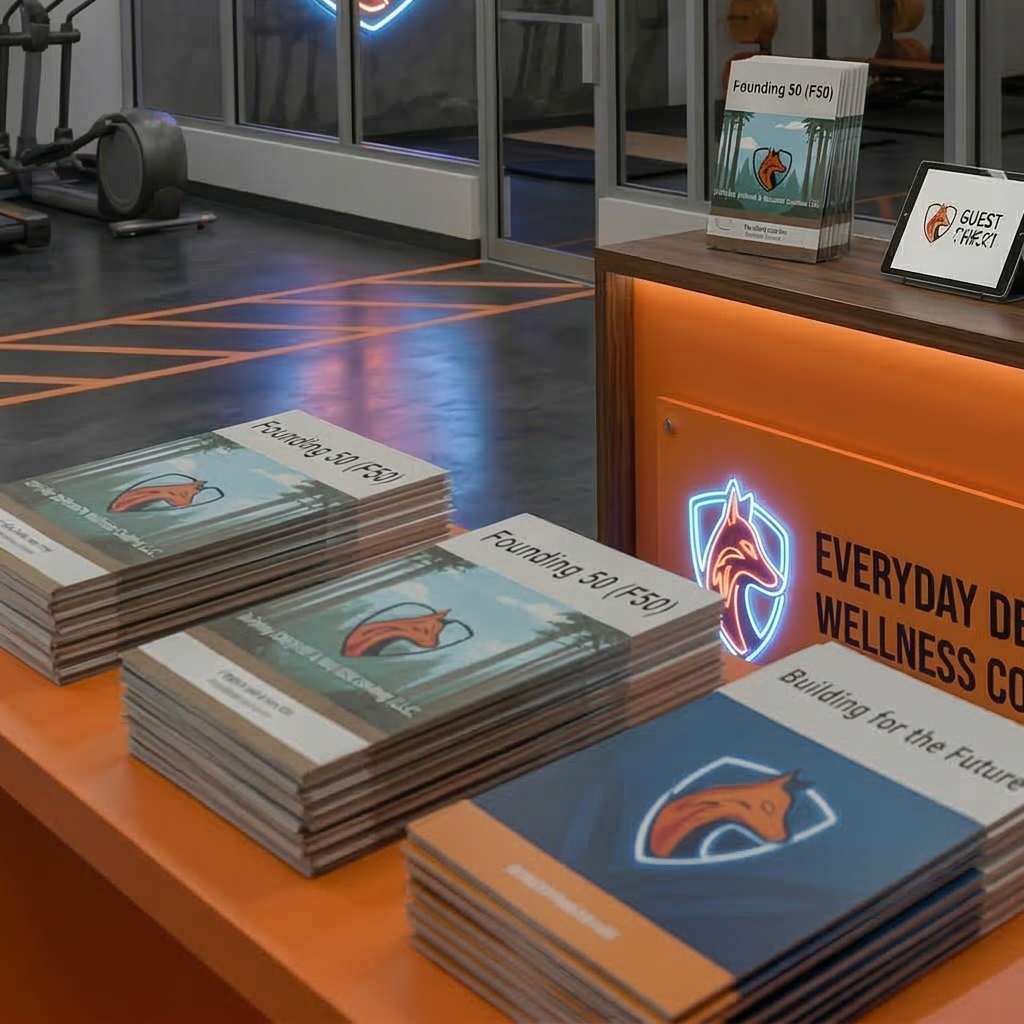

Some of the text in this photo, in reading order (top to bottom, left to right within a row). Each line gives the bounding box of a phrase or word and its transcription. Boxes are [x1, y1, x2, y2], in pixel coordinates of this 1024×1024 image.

[960, 209, 1004, 230] GUEST
[251, 420, 332, 458] Founding
[324, 451, 360, 466] 50
[480, 530, 679, 618] Founding 50 (F50)
[816, 531, 978, 628] EVERYDAY
[816, 591, 977, 693] WELLNESS
[778, 668, 870, 720] Building
[867, 709, 910, 735] for
[904, 726, 946, 755] the
